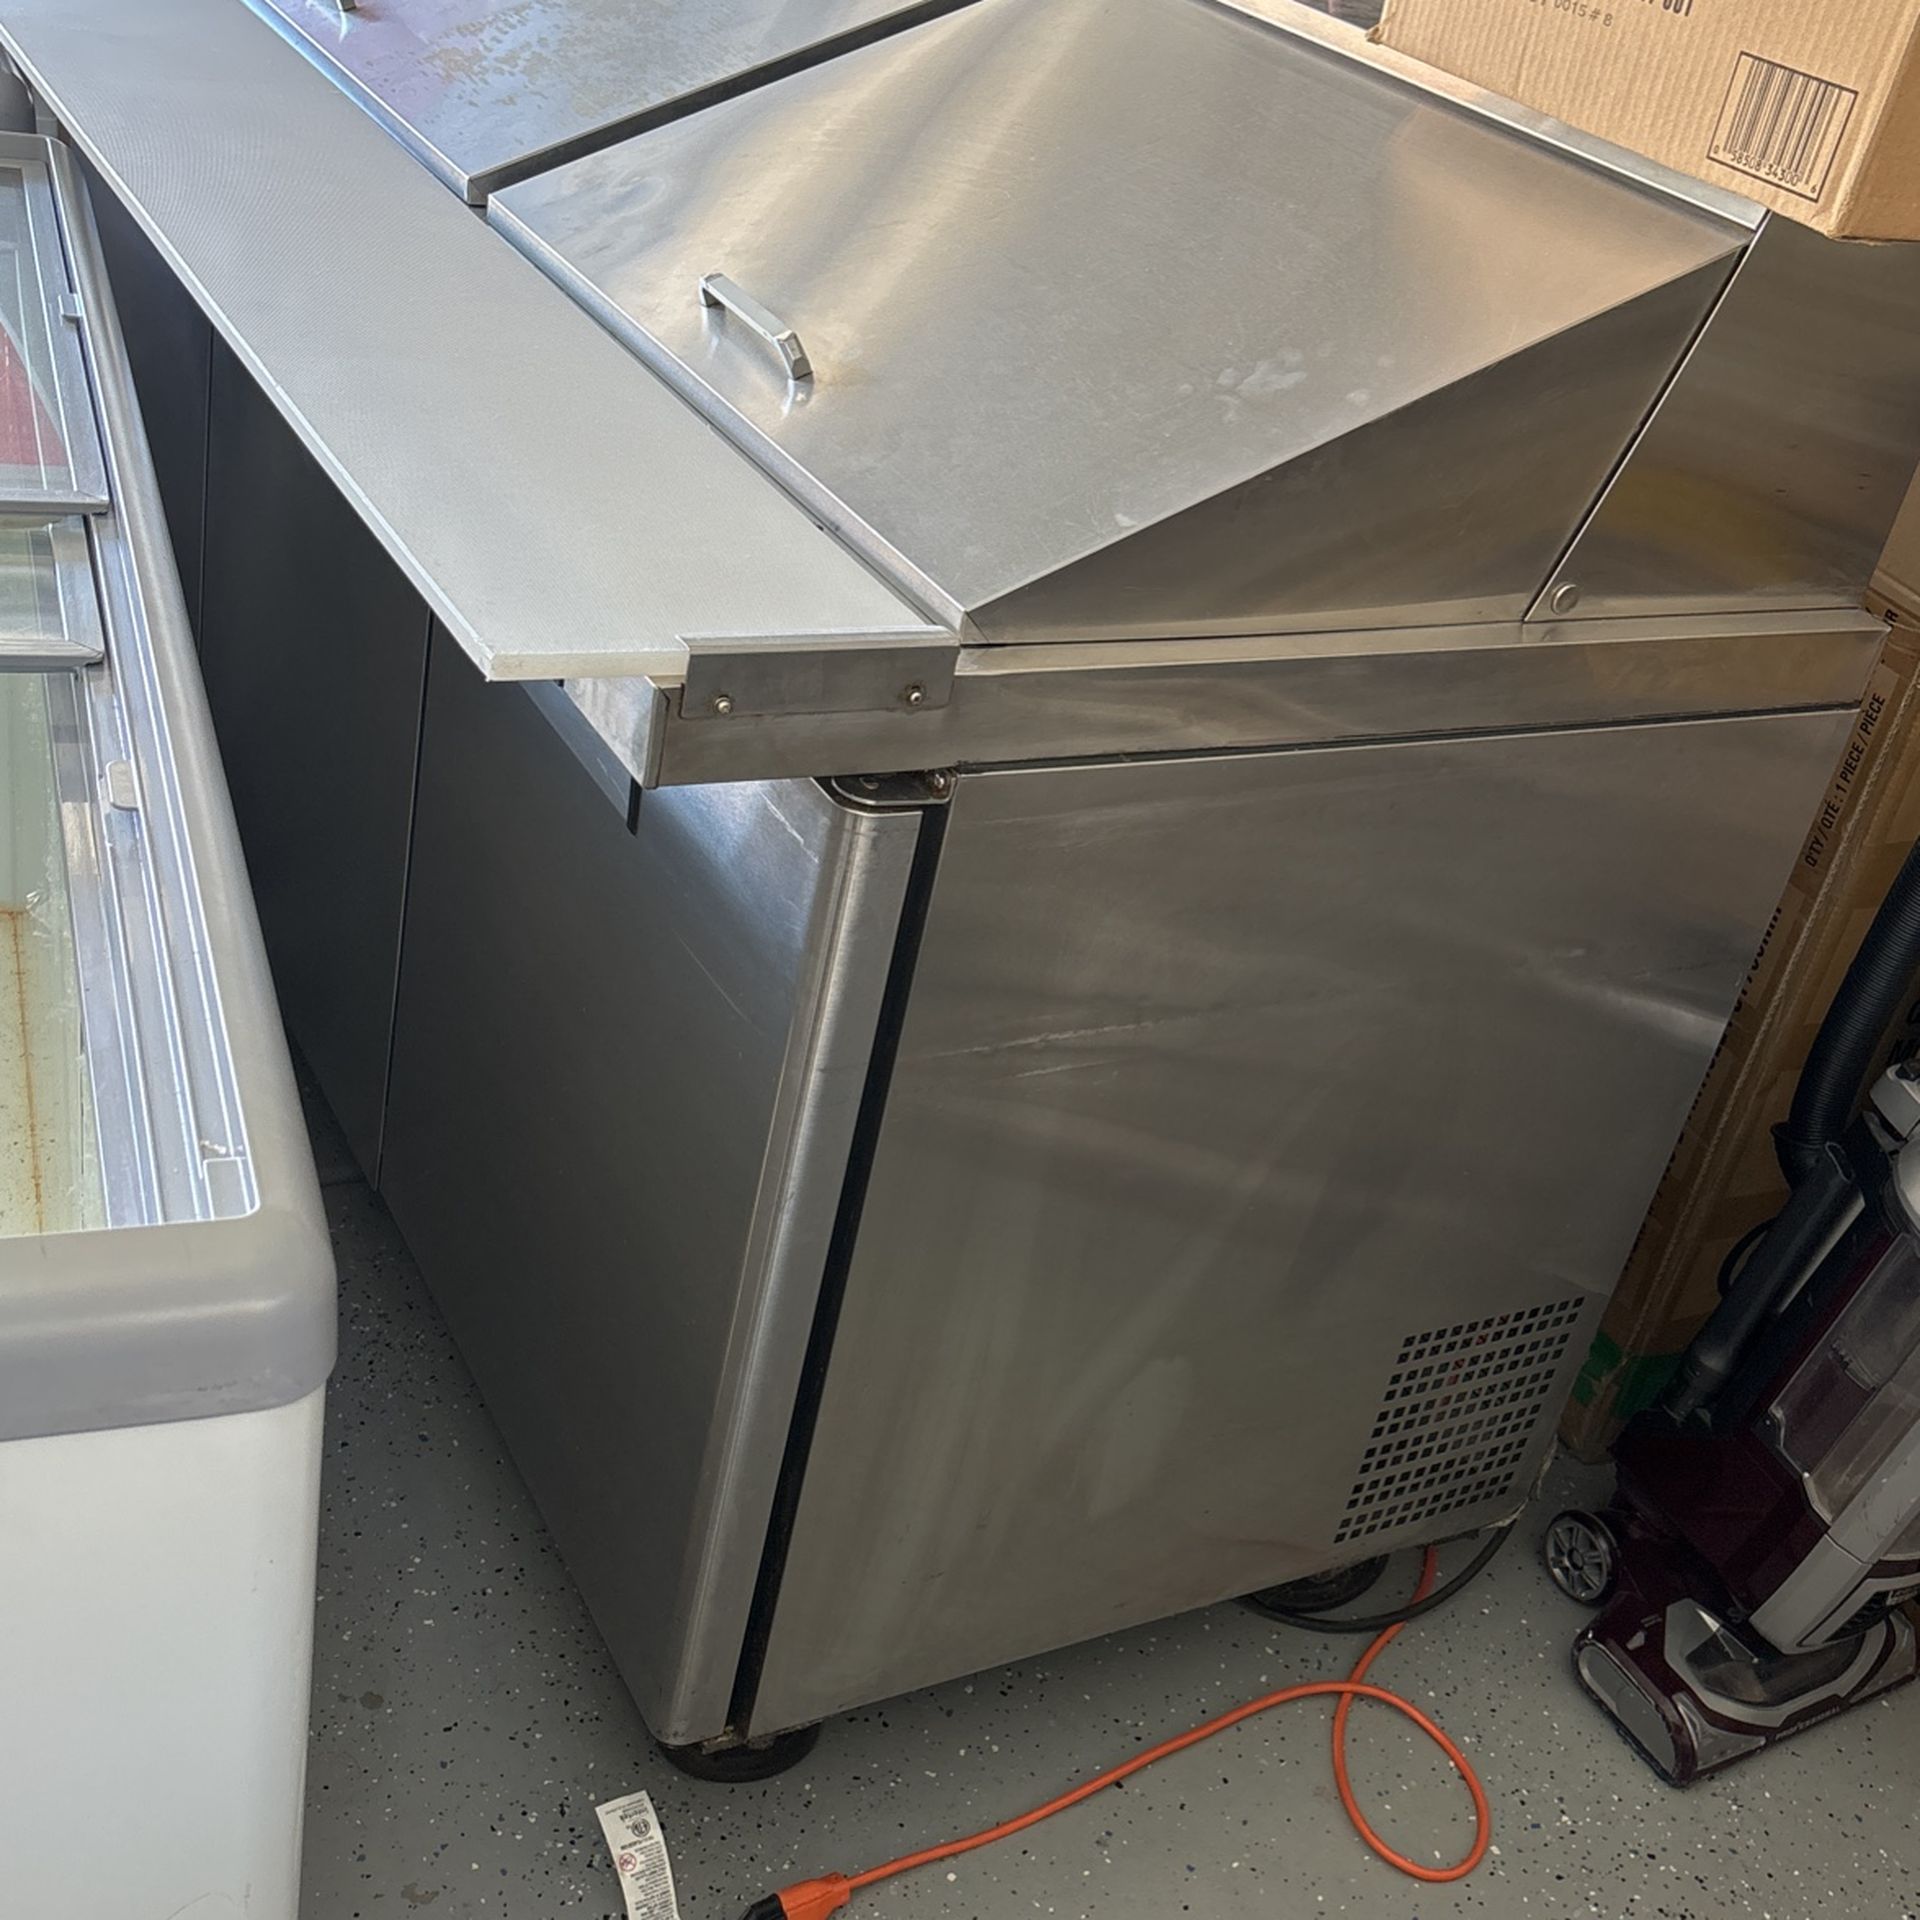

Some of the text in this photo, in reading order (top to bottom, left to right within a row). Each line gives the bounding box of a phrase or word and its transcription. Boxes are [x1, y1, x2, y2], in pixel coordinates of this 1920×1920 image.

[1602, 13, 1613, 28] 8
[1730, 151, 1762, 172] 58508
[1764, 163, 1800, 187] 34300
[1839, 741, 1865, 785] PIECE
[1859, 693, 1886, 736] PIÈCE
